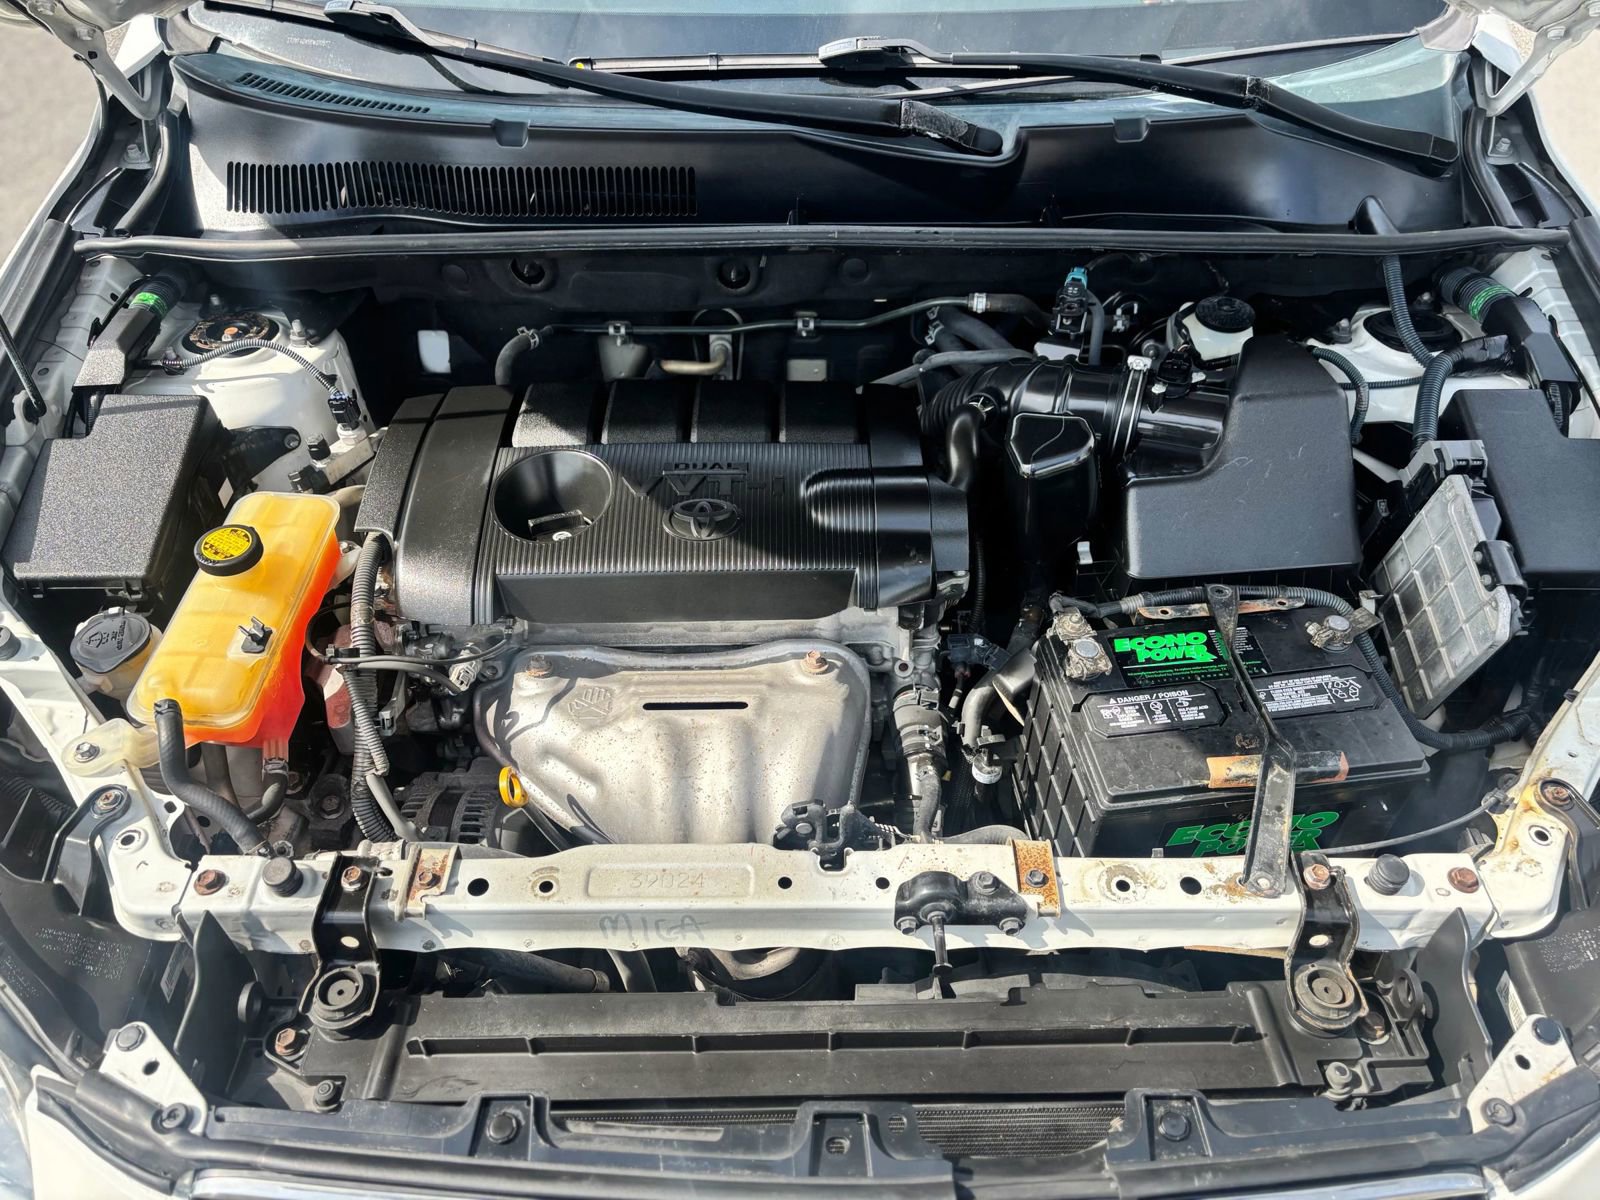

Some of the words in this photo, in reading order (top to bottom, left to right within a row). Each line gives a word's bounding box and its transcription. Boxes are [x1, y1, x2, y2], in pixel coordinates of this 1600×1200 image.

[674, 462, 740, 470] DUAL
[1114, 631, 1207, 652] ECONO
[1136, 645, 1217, 662] POWER
[1117, 694, 1151, 703] DANGER
[1158, 690, 1189, 699] POISON
